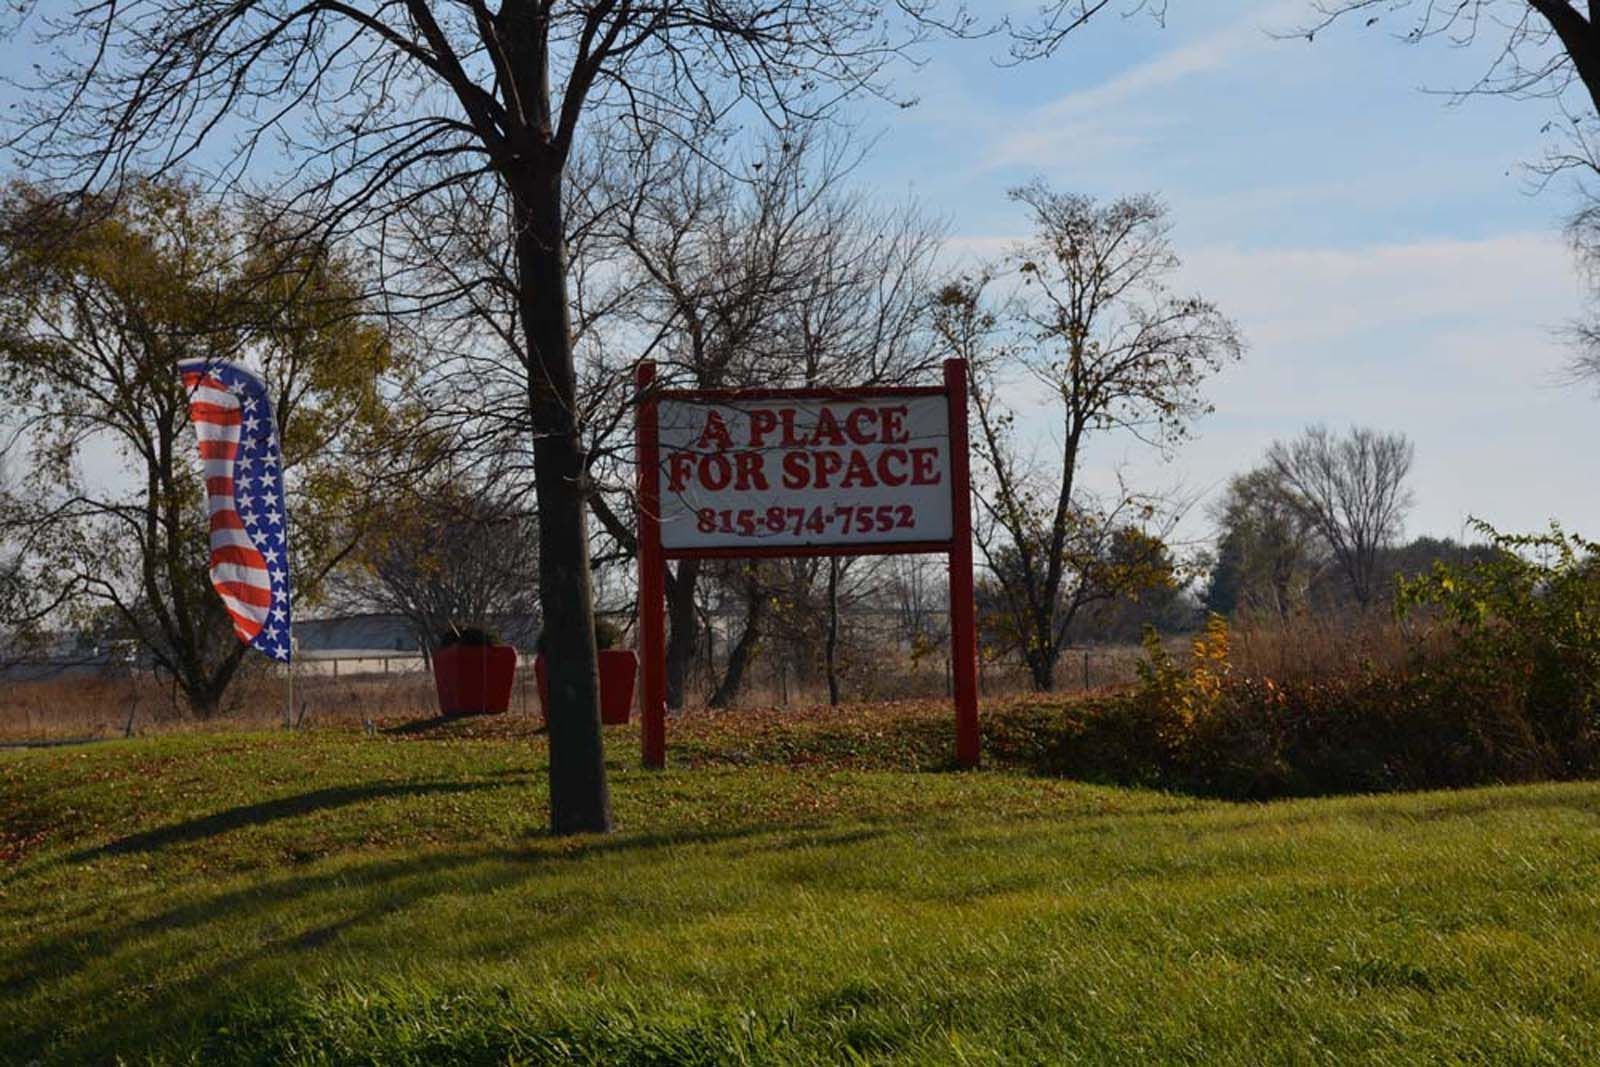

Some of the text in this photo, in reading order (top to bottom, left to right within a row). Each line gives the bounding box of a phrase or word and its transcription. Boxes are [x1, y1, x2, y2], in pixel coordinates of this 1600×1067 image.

[697, 405, 910, 448] A PLACE
[667, 447, 942, 491] FOR SPACE
[697, 505, 916, 536] 815-874-7552
